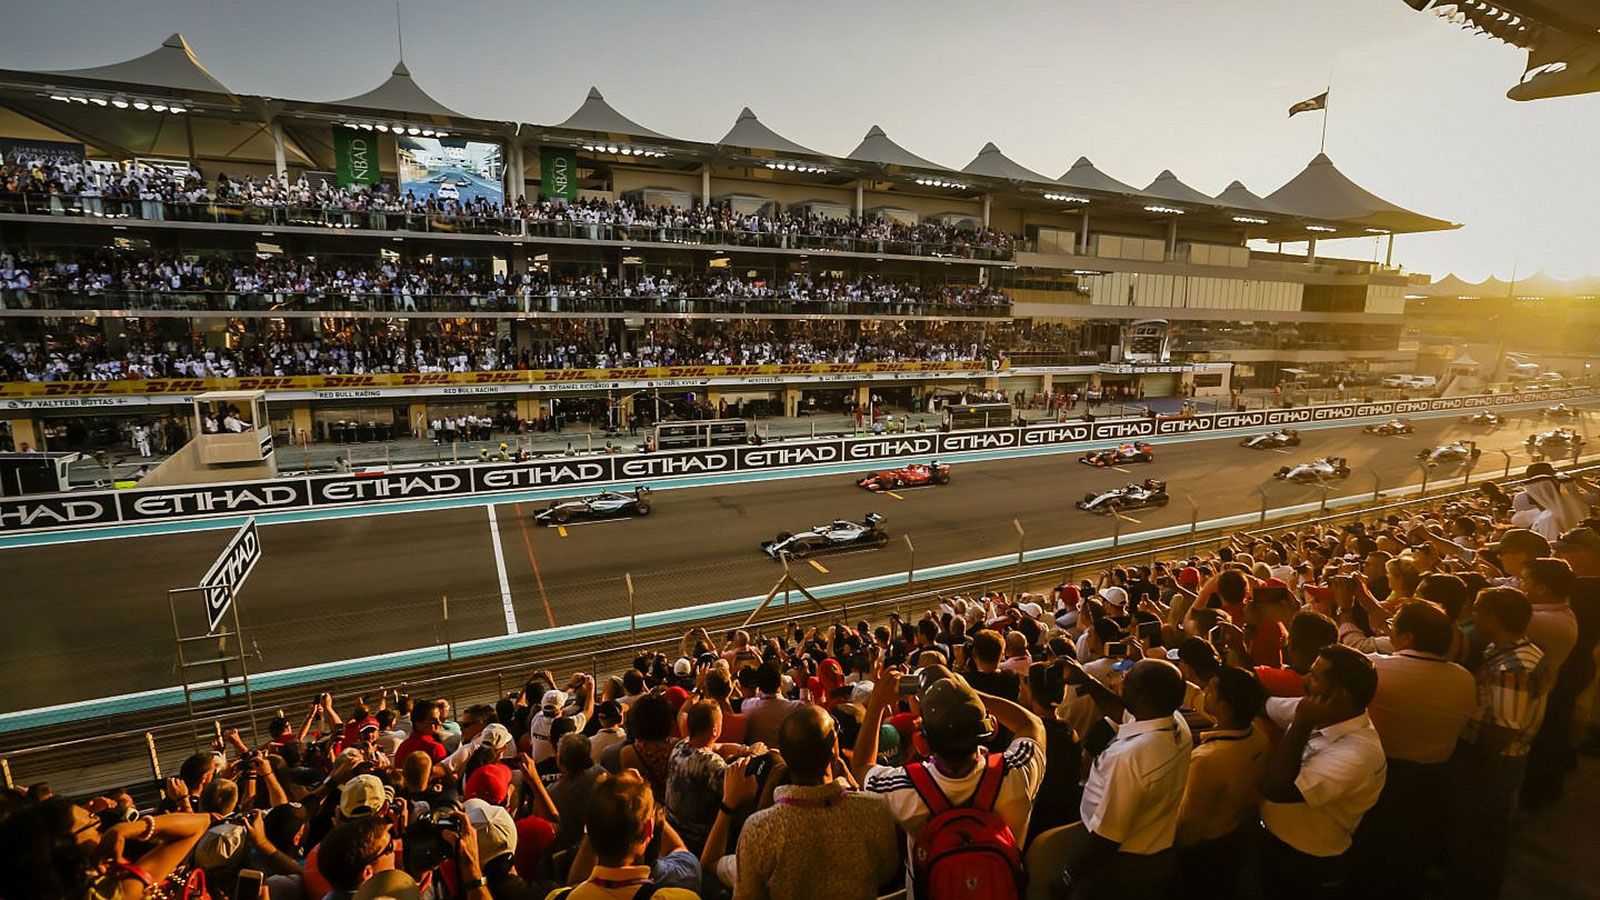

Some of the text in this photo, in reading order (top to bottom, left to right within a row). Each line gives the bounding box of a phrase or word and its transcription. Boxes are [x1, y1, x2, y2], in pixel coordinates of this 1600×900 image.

[352, 139, 369, 180] NBAD
[555, 157, 568, 195] NBAD
[725, 366, 761, 376] DHL
[778, 365, 812, 374] DHL
[829, 364, 861, 373] DHL
[876, 363, 907, 372] DHL
[920, 362, 949, 371] DHL
[962, 362, 986, 370] DHL
[475, 372, 522, 383] DHL
[544, 371, 588, 381] DHL
[608, 369, 649, 379] DHL
[669, 368, 708, 377] DHL
[239, 378, 295, 390] DHL
[323, 376, 376, 387] DHL
[402, 374, 451, 385] DHL
[45, 383, 113, 395] DHL
[144, 381, 208, 392] DHL
[1431, 399, 1461, 410] ETIHAD
[1464, 397, 1492, 407] ETIHAD
[1495, 395, 1521, 404] ETIHAD
[1314, 406, 1352, 419] ETIHAD
[1357, 404, 1392, 416] ETIHAD
[1396, 401, 1428, 413] ETIHAD
[1217, 413, 1262, 427] ETIHAD
[1268, 410, 1310, 424] ETIHAD
[1096, 423, 1152, 438] ETIHAD
[1160, 417, 1210, 433] ETIHAD
[943, 432, 1015, 450] ETIHAD
[1024, 427, 1088, 444] ETIHAD
[850, 438, 931, 458] ETIHAD
[744, 446, 837, 467] ETIHAD
[622, 454, 728, 476] ETIHAD
[483, 463, 604, 487] ETIHAD
[322, 473, 461, 500] ETIHAD
[133, 486, 298, 515] ETIHAD
[211, 531, 256, 609] ETIHAD
